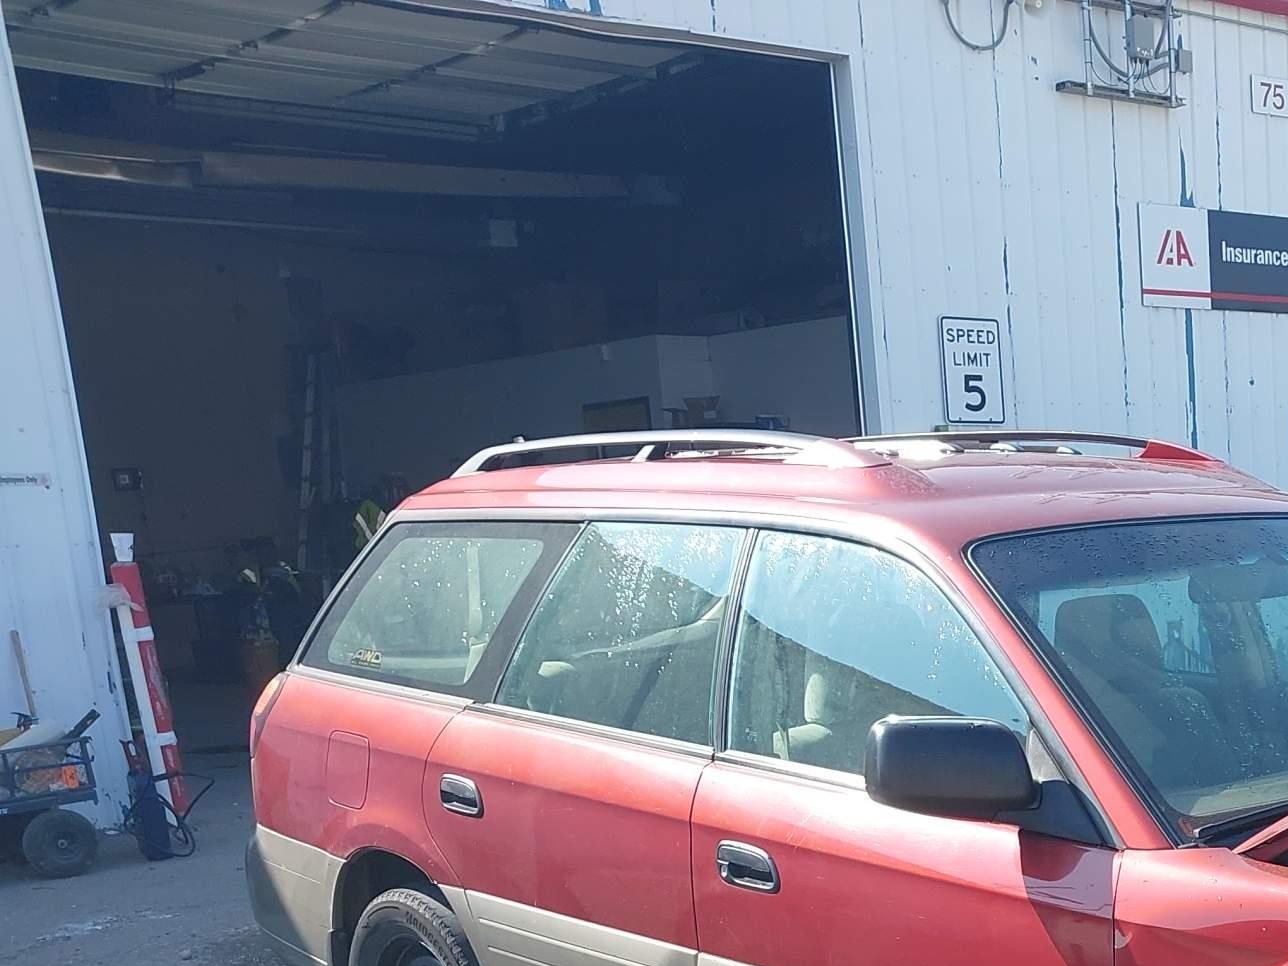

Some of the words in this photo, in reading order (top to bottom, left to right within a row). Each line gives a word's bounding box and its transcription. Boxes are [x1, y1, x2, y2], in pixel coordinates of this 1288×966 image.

[1260, 82, 1285, 110] 75
[1221, 240, 1288, 266] Insurance
[945, 327, 996, 344] SPEED
[953, 351, 992, 367] LIMIT
[964, 374, 986, 412] 5
[352, 649, 382, 664] AWD
